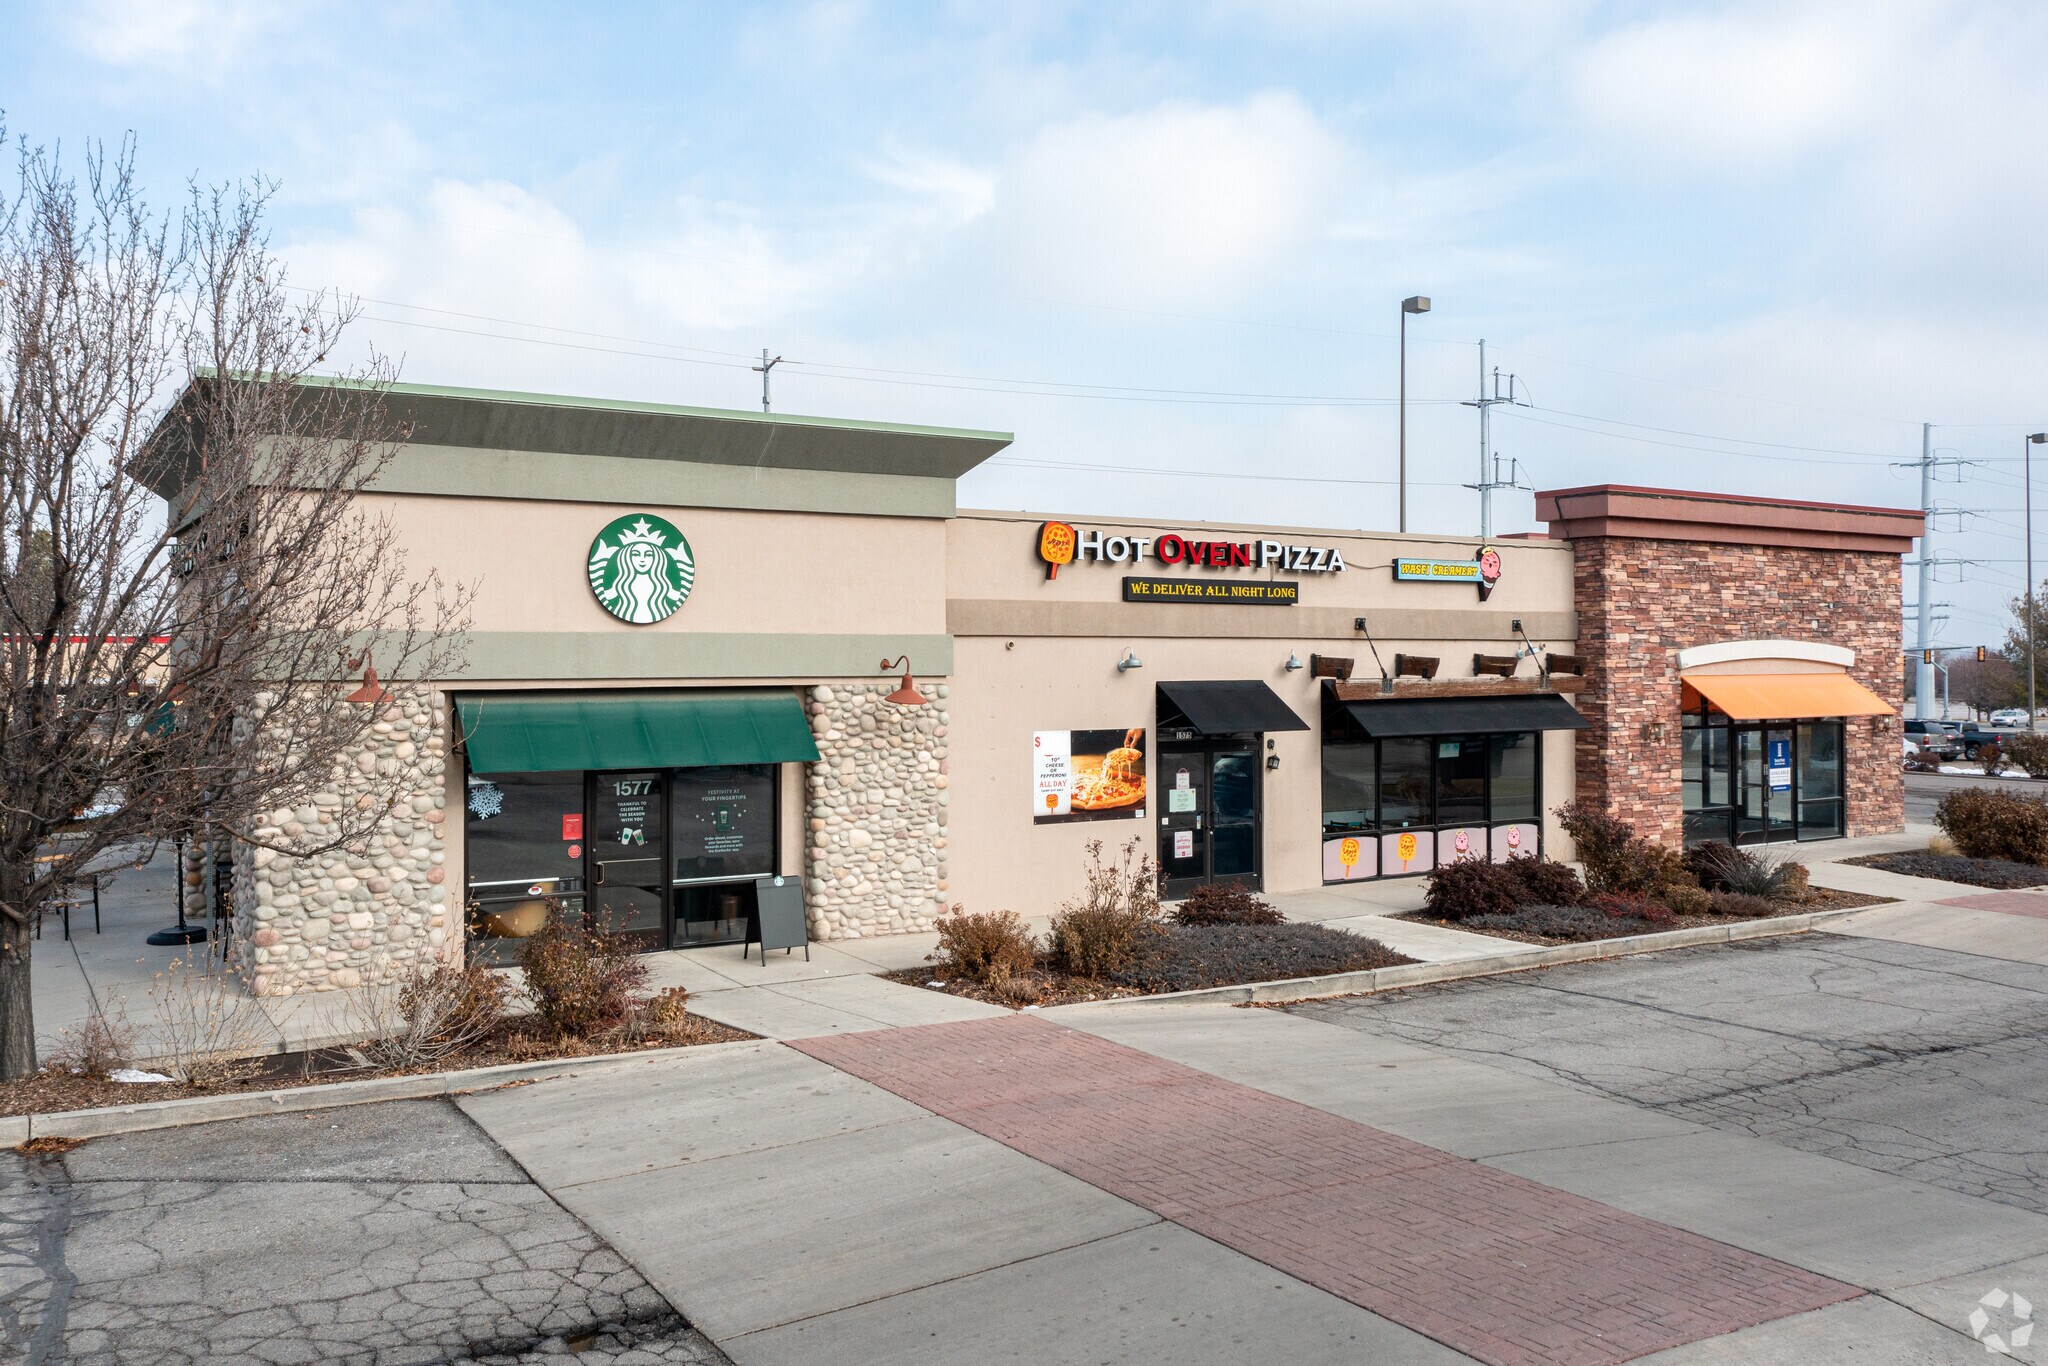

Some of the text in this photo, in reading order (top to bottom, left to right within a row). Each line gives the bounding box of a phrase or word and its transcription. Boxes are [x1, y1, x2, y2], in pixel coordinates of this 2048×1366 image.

[1076, 529, 1348, 572] HOT OVEN PIZZA
[1432, 564, 1478, 577] CREAMERY
[1131, 582, 1296, 598] WE DELIVER ALL NIGHT LONG
[1034, 736, 1041, 748] $
[613, 780, 652, 796] 1577
